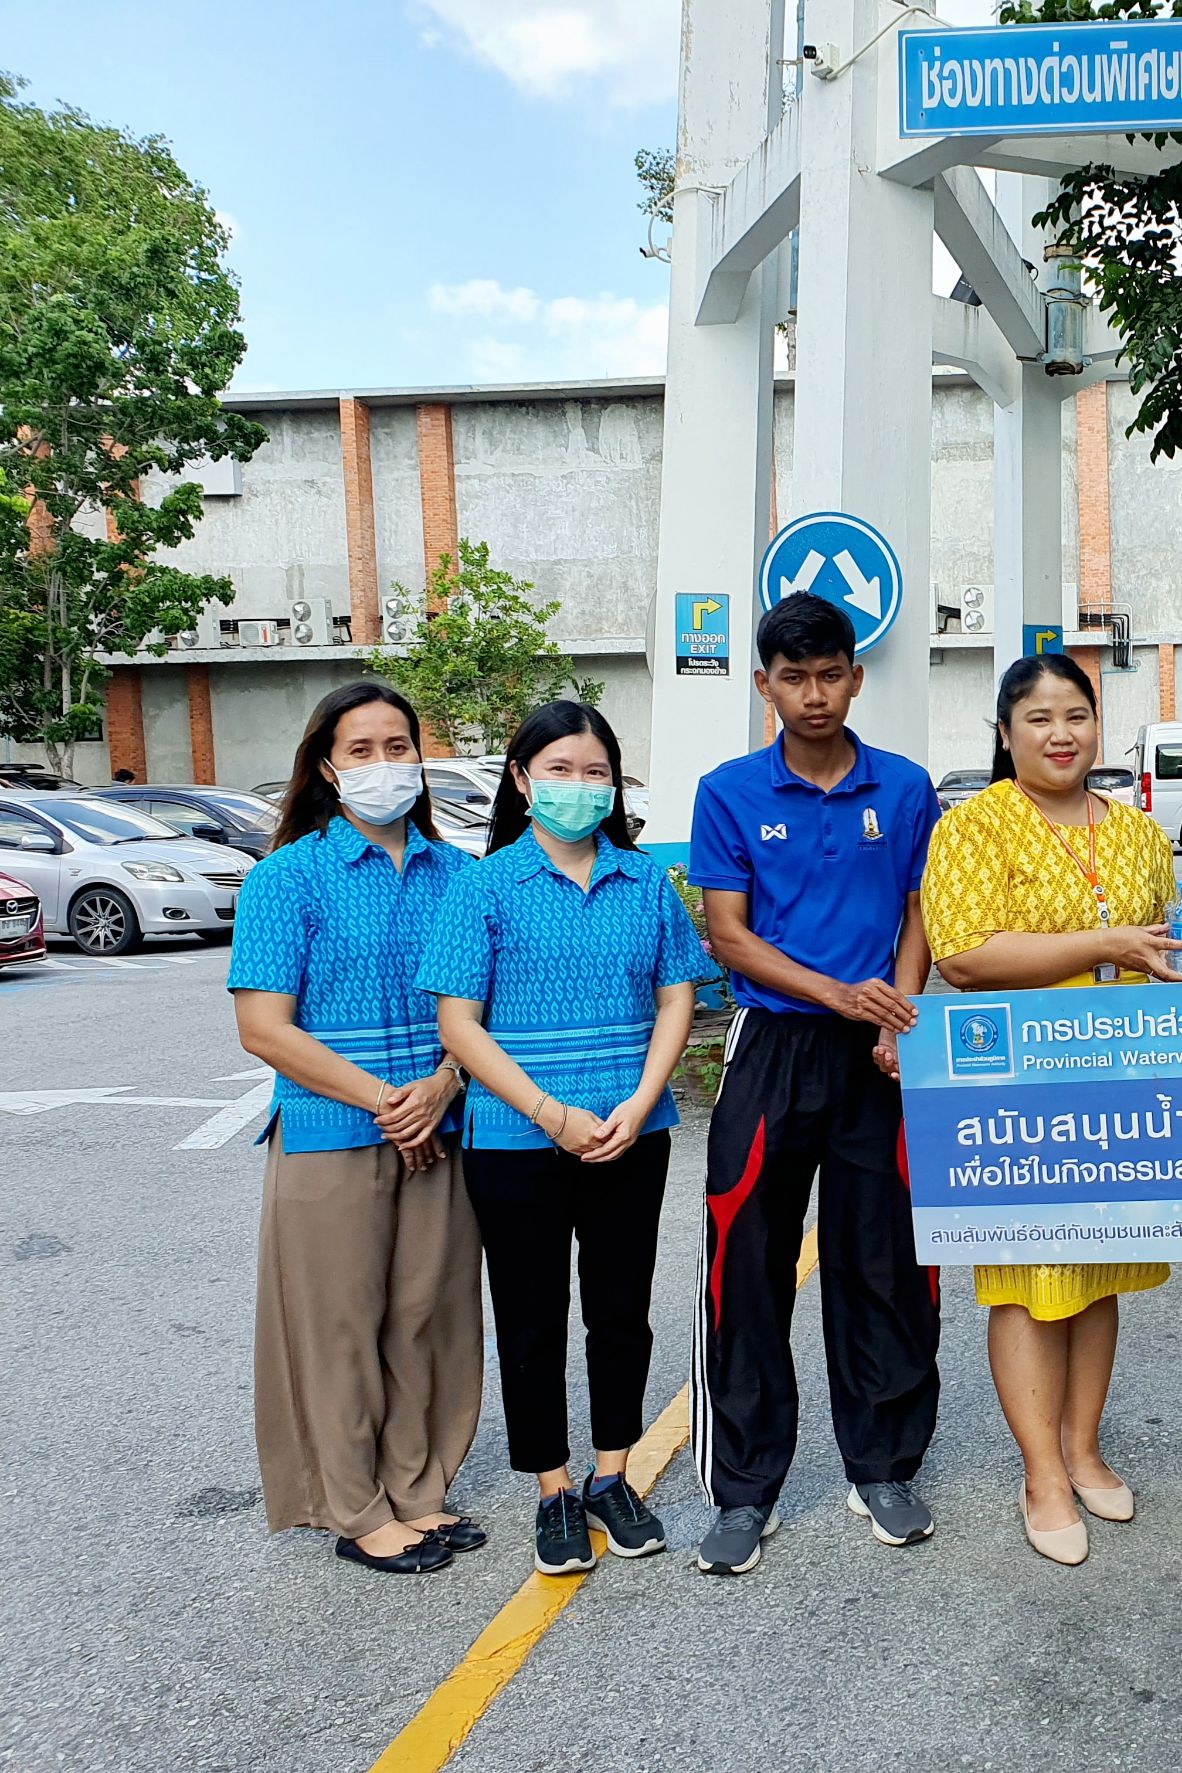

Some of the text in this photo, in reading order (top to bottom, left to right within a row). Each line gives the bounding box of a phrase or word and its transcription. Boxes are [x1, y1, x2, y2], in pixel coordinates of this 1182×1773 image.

[681, 633, 726, 643] ทางออก
[690, 644, 717, 654] EXIT
[1023, 1051, 1113, 1071] Provincial
